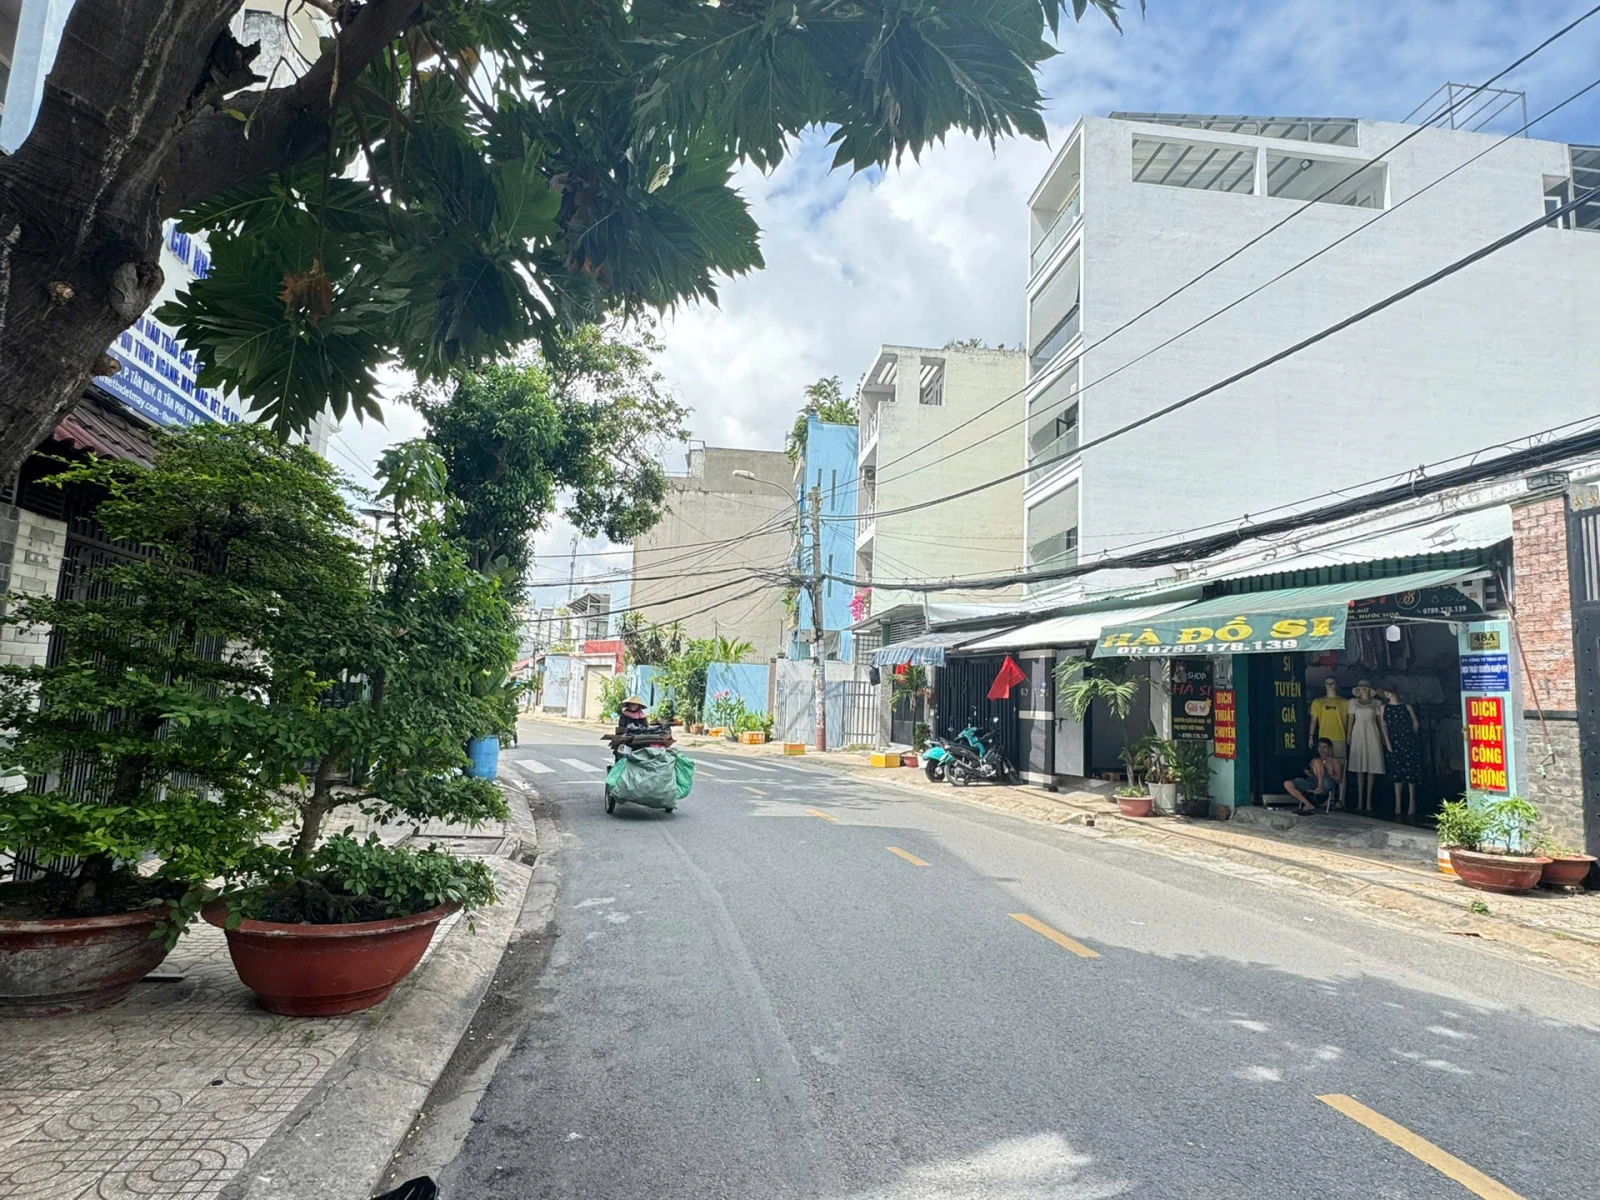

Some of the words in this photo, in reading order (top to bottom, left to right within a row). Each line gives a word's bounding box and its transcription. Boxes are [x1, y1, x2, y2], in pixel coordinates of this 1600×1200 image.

[130, 369, 143, 389] TÂN
[163, 392, 174, 412] TÂN
[1176, 615, 1253, 644] ĐỒ
[1270, 616, 1335, 639] SI
[1474, 633, 1496, 641] 48A
[1148, 639, 1298, 654] 0789.178.139
[1187, 671, 1207, 680] SHOP
[1173, 681, 1194, 696] HÀ
[1200, 685, 1212, 696] SI
[1216, 692, 1232, 707] DỊCH
[1214, 707, 1235, 724] THUẬT
[1281, 704, 1296, 723] GIÁ
[1471, 701, 1497, 720] DỊCH
[1284, 728, 1296, 749] RẺ
[1468, 722, 1502, 744] THUẬT
[1472, 744, 1502, 764] CÔNG
[1470, 766, 1507, 787] CHỨNG
